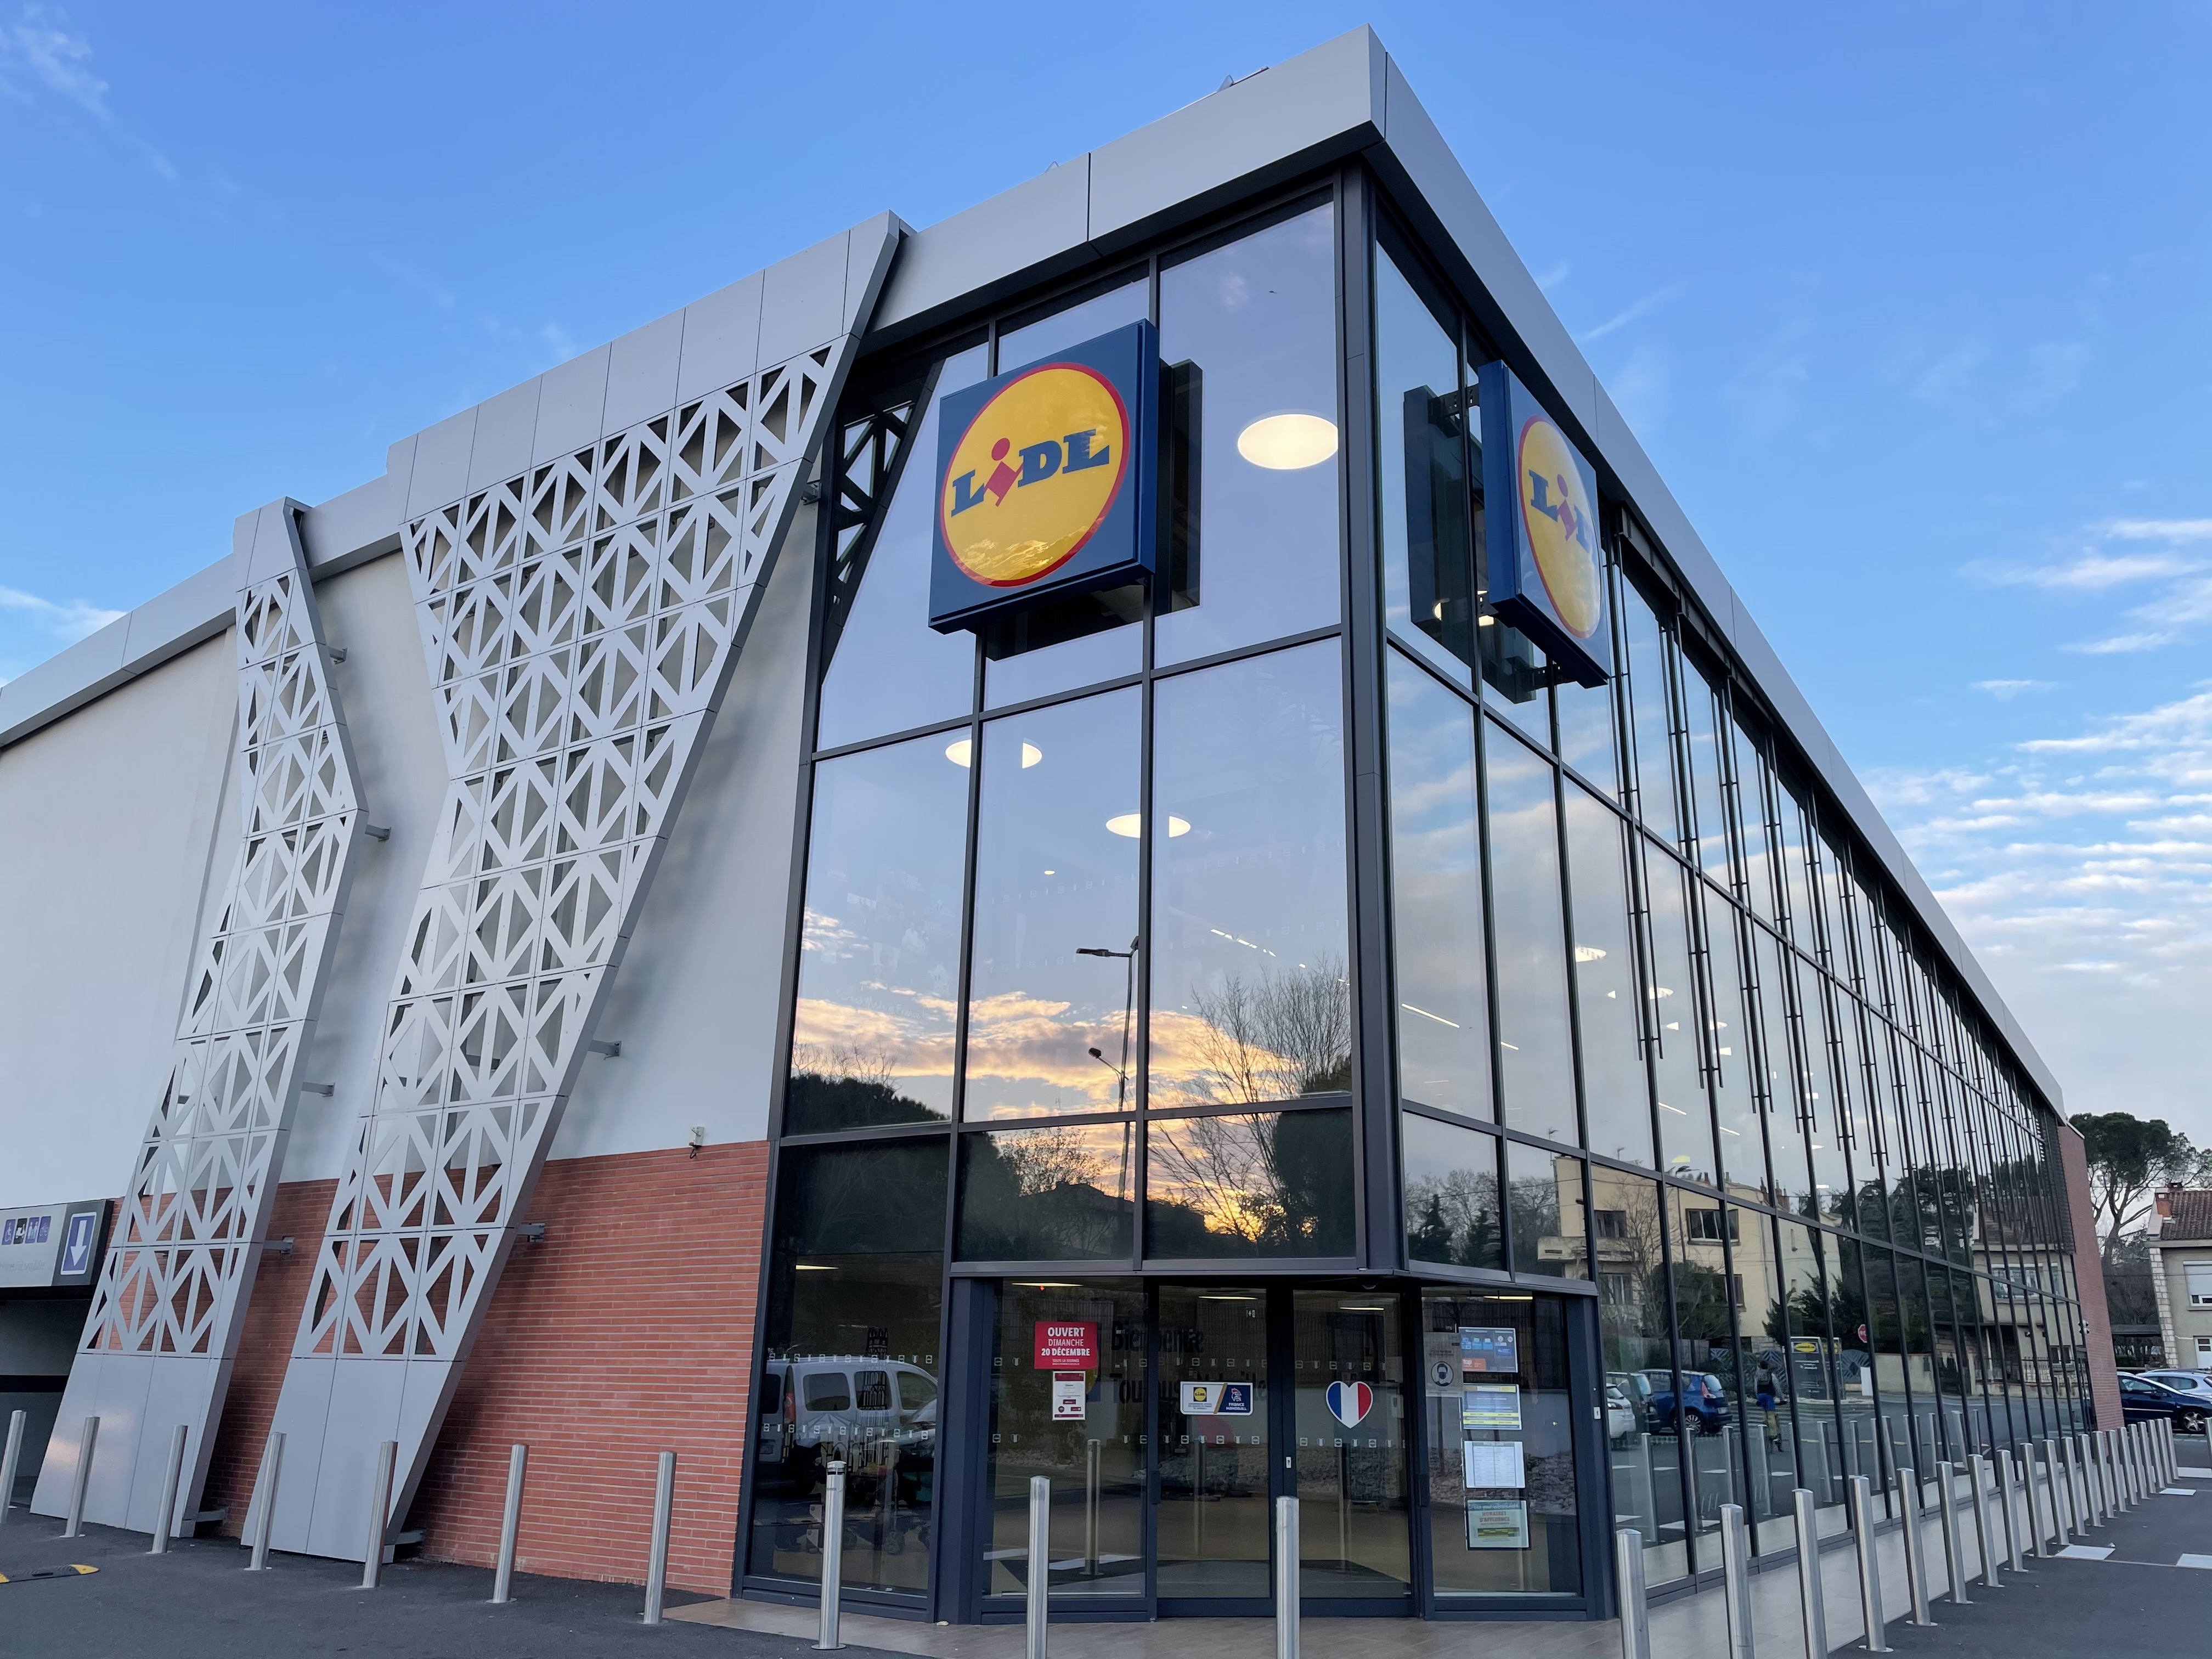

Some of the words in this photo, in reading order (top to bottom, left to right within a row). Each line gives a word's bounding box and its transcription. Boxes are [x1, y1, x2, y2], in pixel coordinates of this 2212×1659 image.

[1047, 1327, 1085, 1337] OUVERT
[1041, 1348, 1050, 1356] 20
[1052, 1346, 1090, 1356] DÉCEMBRE
